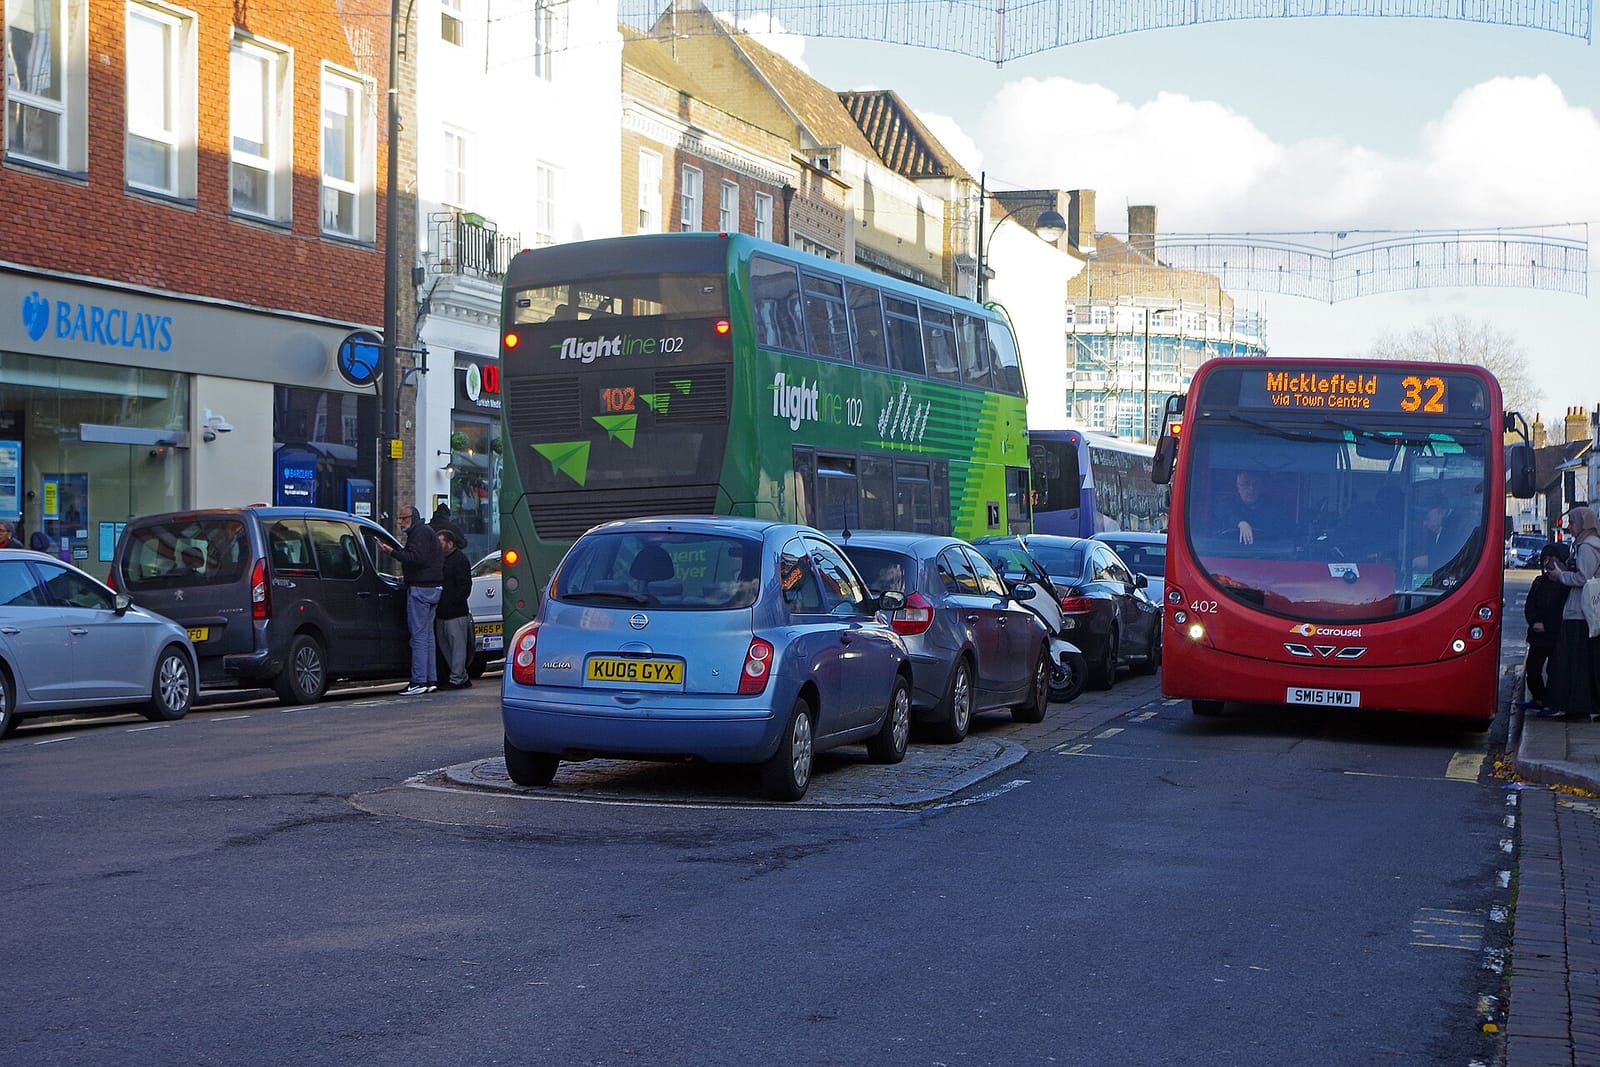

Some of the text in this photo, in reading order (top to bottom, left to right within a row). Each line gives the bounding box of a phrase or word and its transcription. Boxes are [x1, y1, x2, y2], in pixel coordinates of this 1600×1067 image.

[55, 300, 173, 352] BARCLAYS
[560, 334, 684, 364] flightline 102
[1266, 371, 1378, 395] Micklefield
[602, 386, 636, 412] 102
[773, 371, 842, 431] flightline
[846, 396, 863, 427] 102
[1271, 393, 1370, 408] via Town Centre
[1400, 375, 1446, 413] 32
[290, 468, 313, 479] BARCLAYS
[1190, 600, 1218, 613] 402
[1316, 628, 1362, 638] carousel
[542, 661, 571, 669] MICRA
[594, 661, 676, 681] KU06 GYX
[1295, 689, 1352, 705] SM15 HWD
